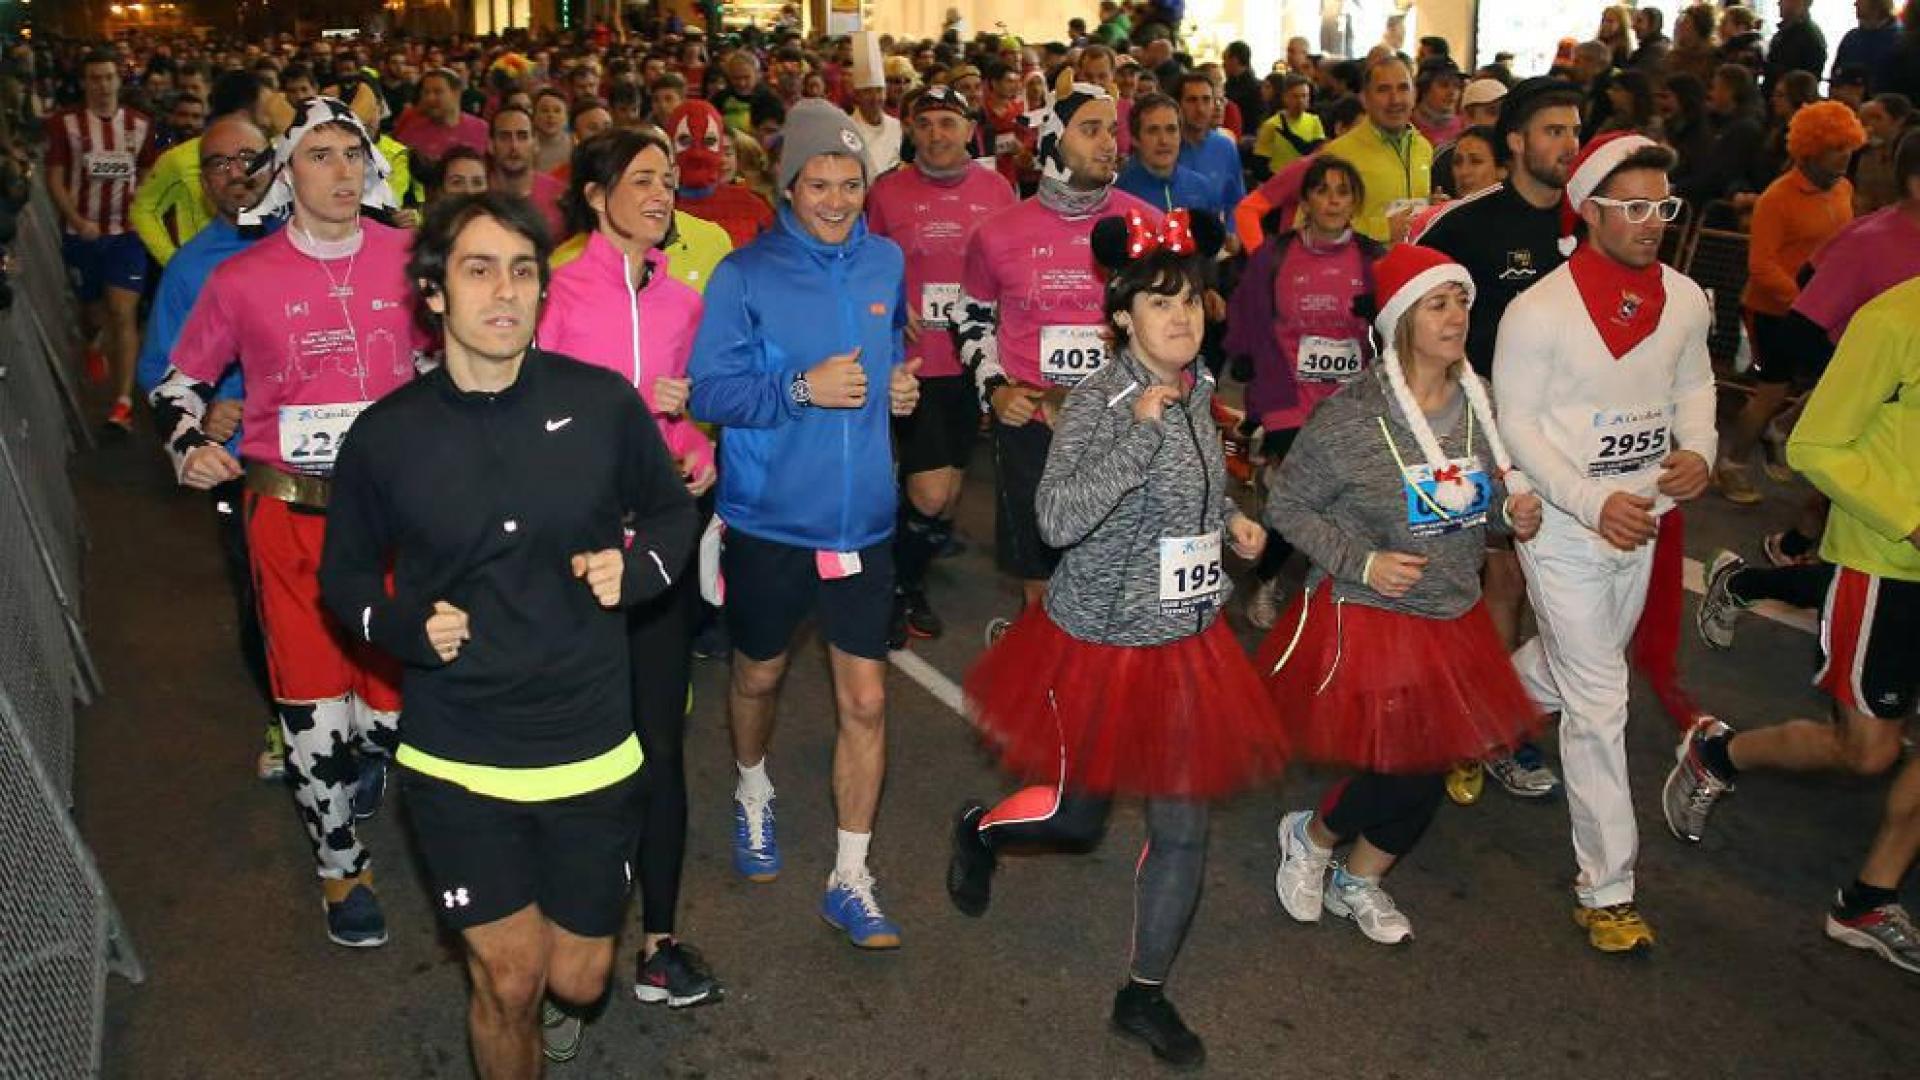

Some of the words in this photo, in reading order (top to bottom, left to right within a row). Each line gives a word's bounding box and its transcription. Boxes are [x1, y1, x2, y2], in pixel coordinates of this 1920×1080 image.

[1048, 348, 1101, 369] 403
[1598, 426, 1666, 458] 2955
[1173, 560, 1220, 592] 195
